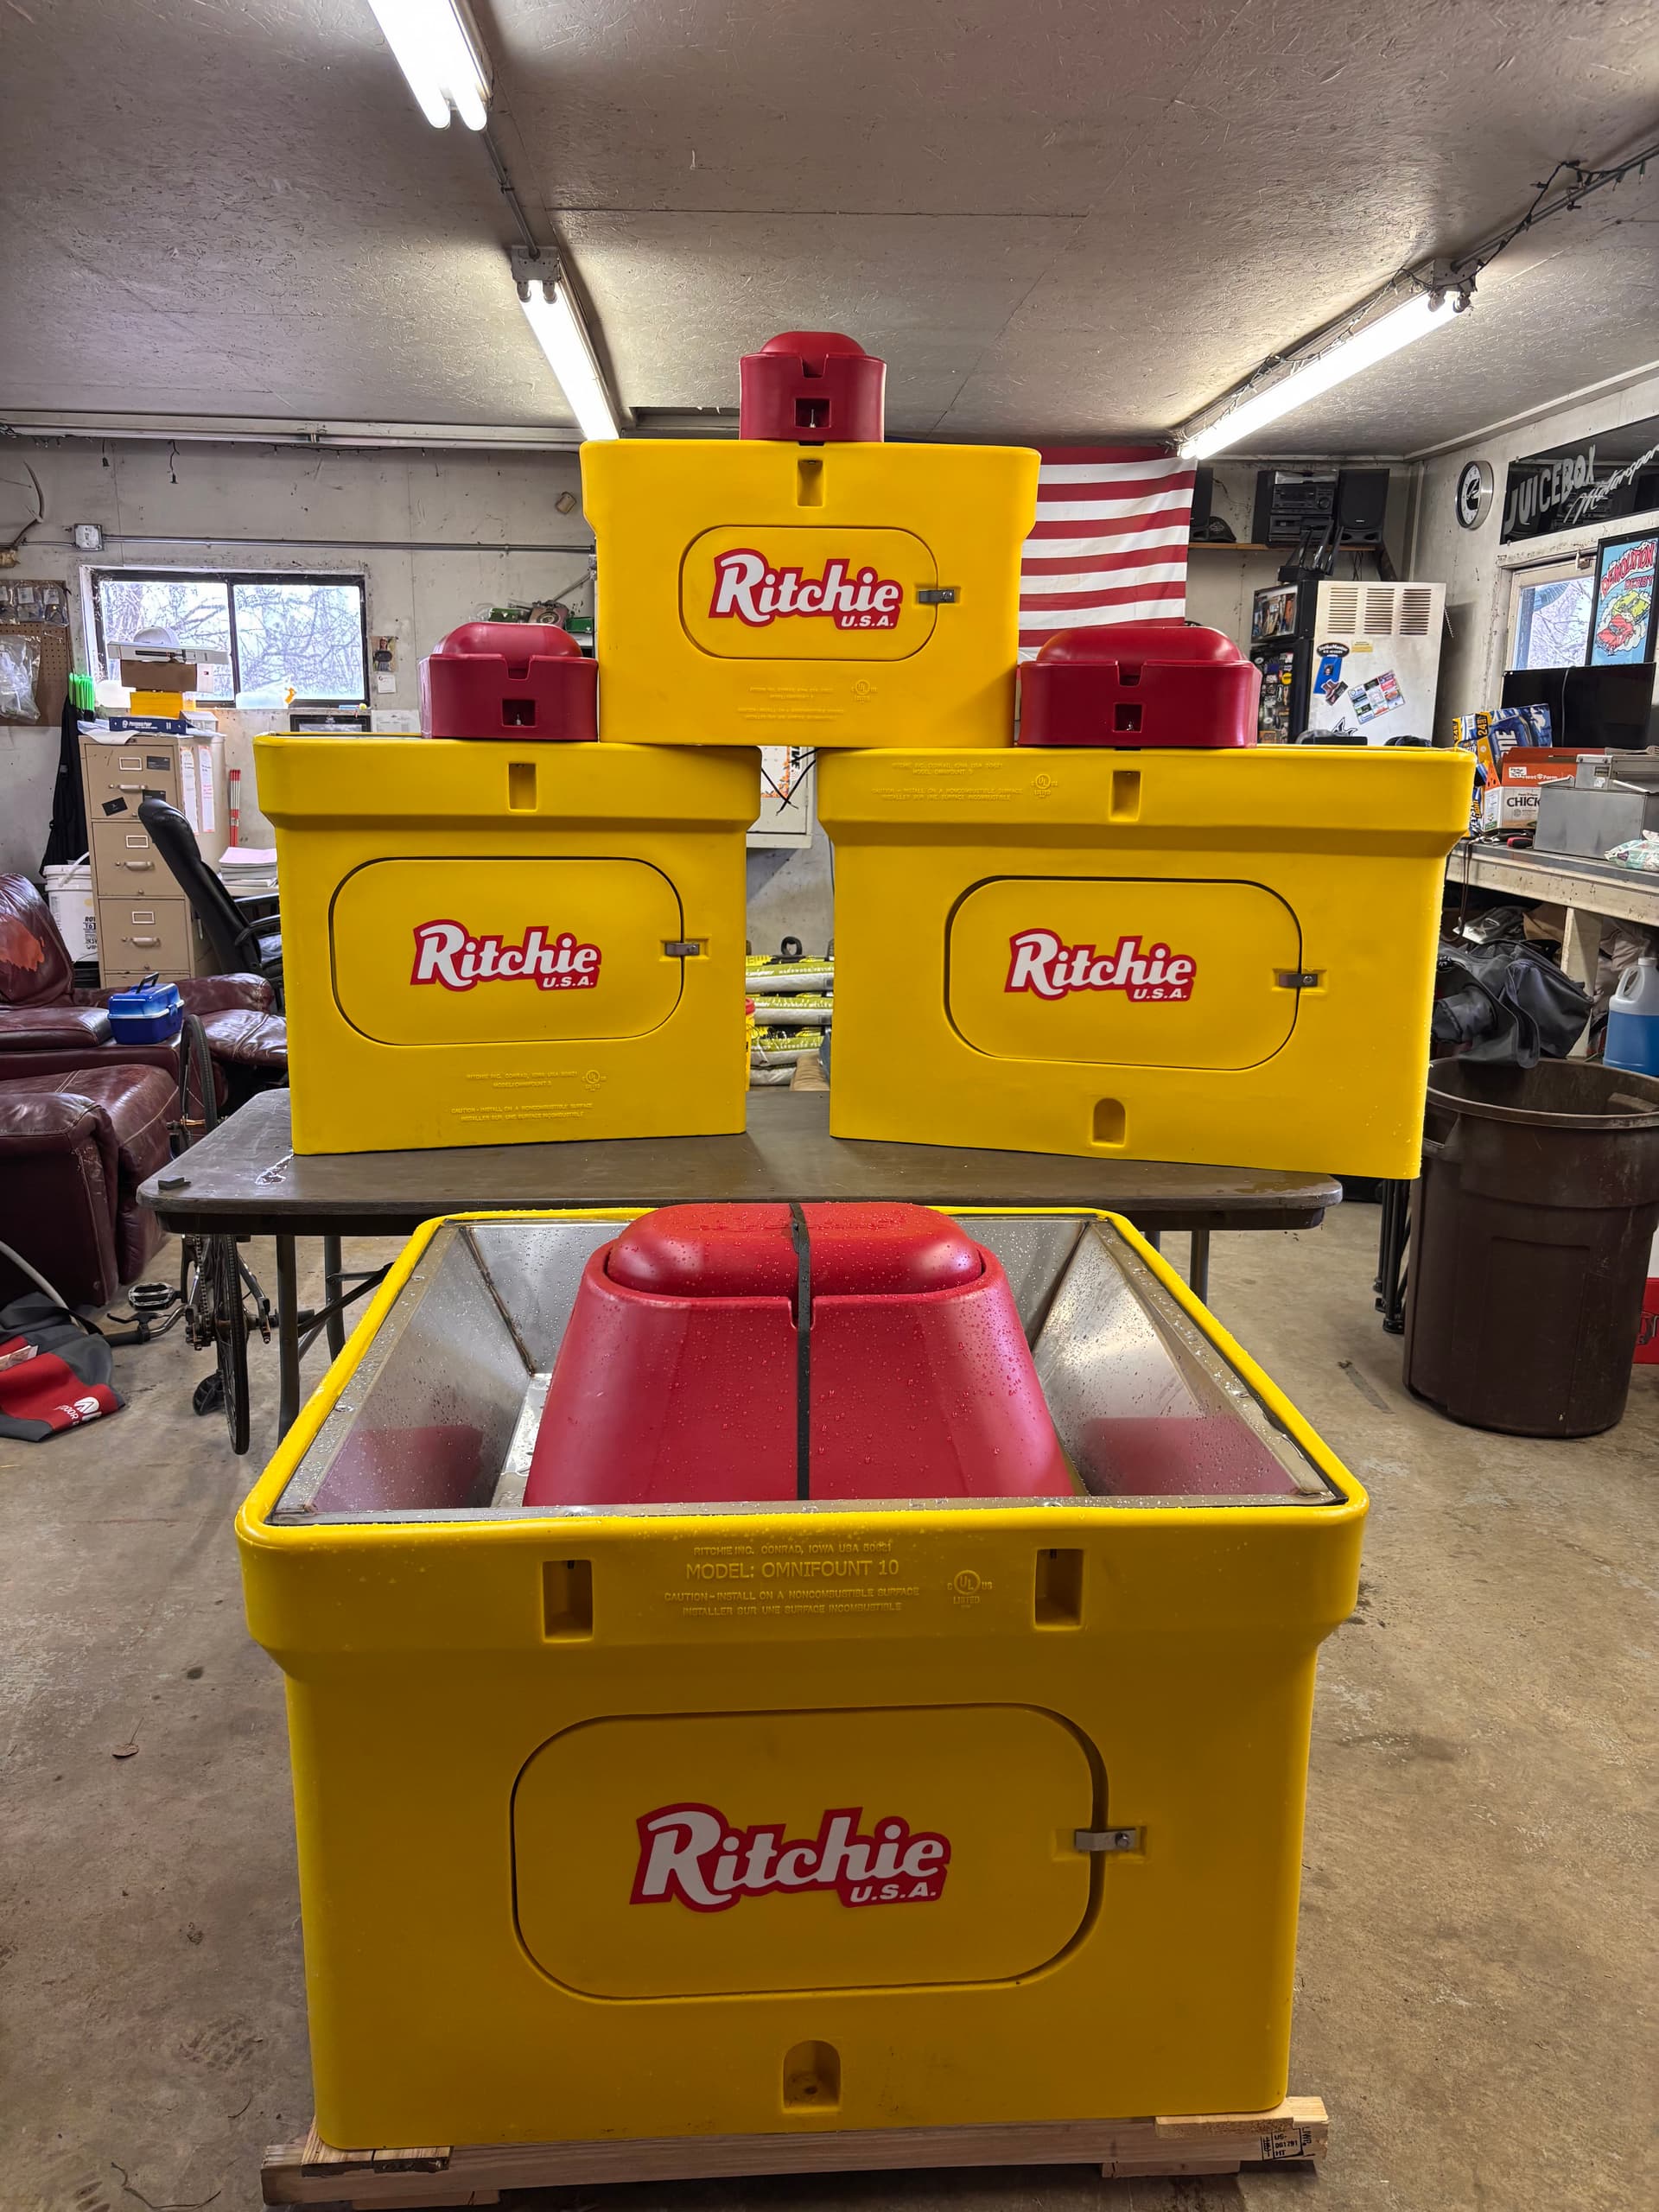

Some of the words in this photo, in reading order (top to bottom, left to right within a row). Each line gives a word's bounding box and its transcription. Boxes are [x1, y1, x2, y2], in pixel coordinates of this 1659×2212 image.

[1503, 444, 1596, 536] JUICEBOX
[1601, 542, 1656, 596] DEMOLITION
[720, 554, 899, 623] Ritchie
[1624, 575, 1654, 591] DERBY
[841, 614, 895, 628] U.S.A.
[417, 924, 598, 987] Ritchie
[1011, 933, 1192, 995] Ritchie
[543, 976, 594, 988] U.S.A.
[1134, 988, 1187, 1001] U.S.A.
[693, 1546, 733, 1555] RITCHIE
[734, 1545, 754, 1555] INC.
[761, 1544, 804, 1555] CONRAD,
[809, 1543, 834, 1554] IOWA
[838, 1542, 859, 1553] USA
[686, 1562, 754, 1580] MODEL:
[761, 1560, 873, 1578] OMNIFOUNT
[879, 1559, 899, 1575] 10
[760, 1590, 773, 1599] ON
[777, 1590, 785, 1599] A
[641, 1810, 944, 1906] Ritchie
[849, 1881, 937, 1903] U.S.A.
